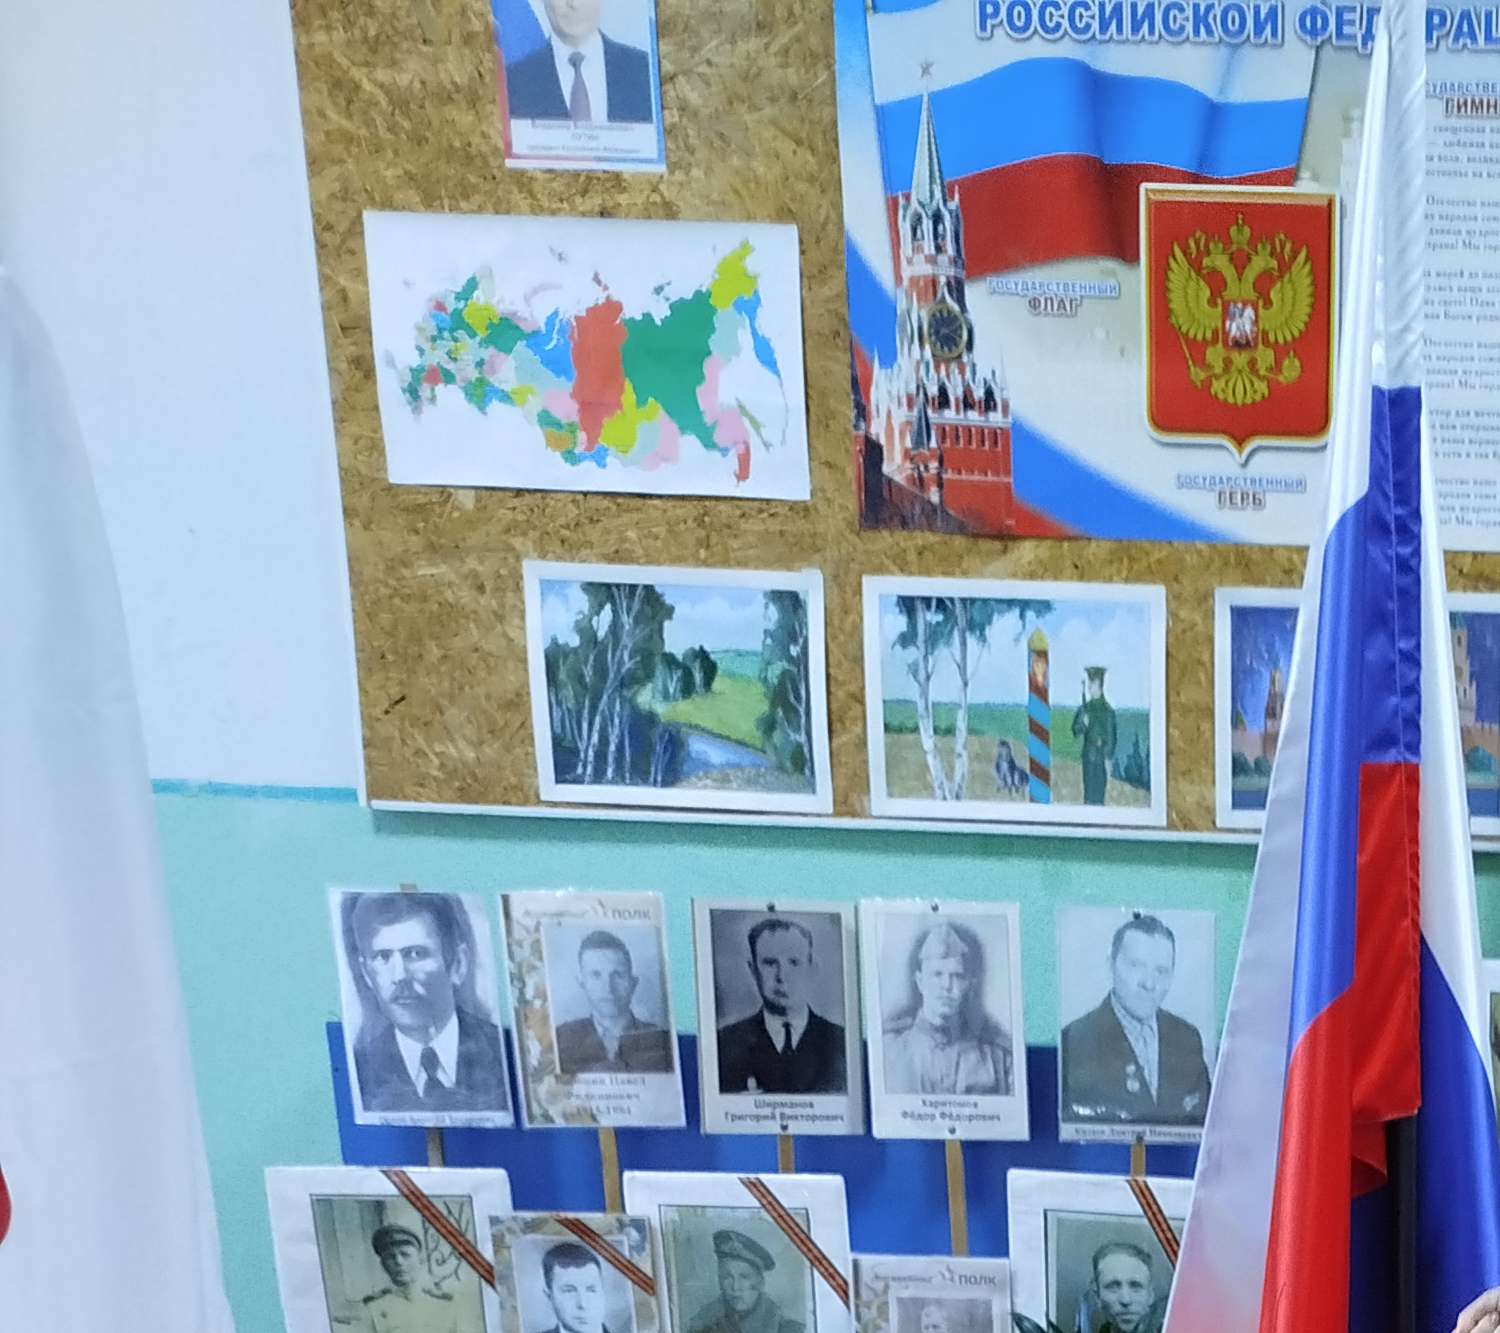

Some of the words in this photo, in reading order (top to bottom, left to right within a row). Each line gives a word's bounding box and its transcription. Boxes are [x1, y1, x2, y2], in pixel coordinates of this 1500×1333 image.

[1445, 97, 1499, 115] ГИМН
[988, 278, 1117, 294] ГОСУДАРСТВЕННЫЙ
[1028, 297, 1078, 312] ФЛАГ
[1218, 490, 1263, 506] ГЕРБ
